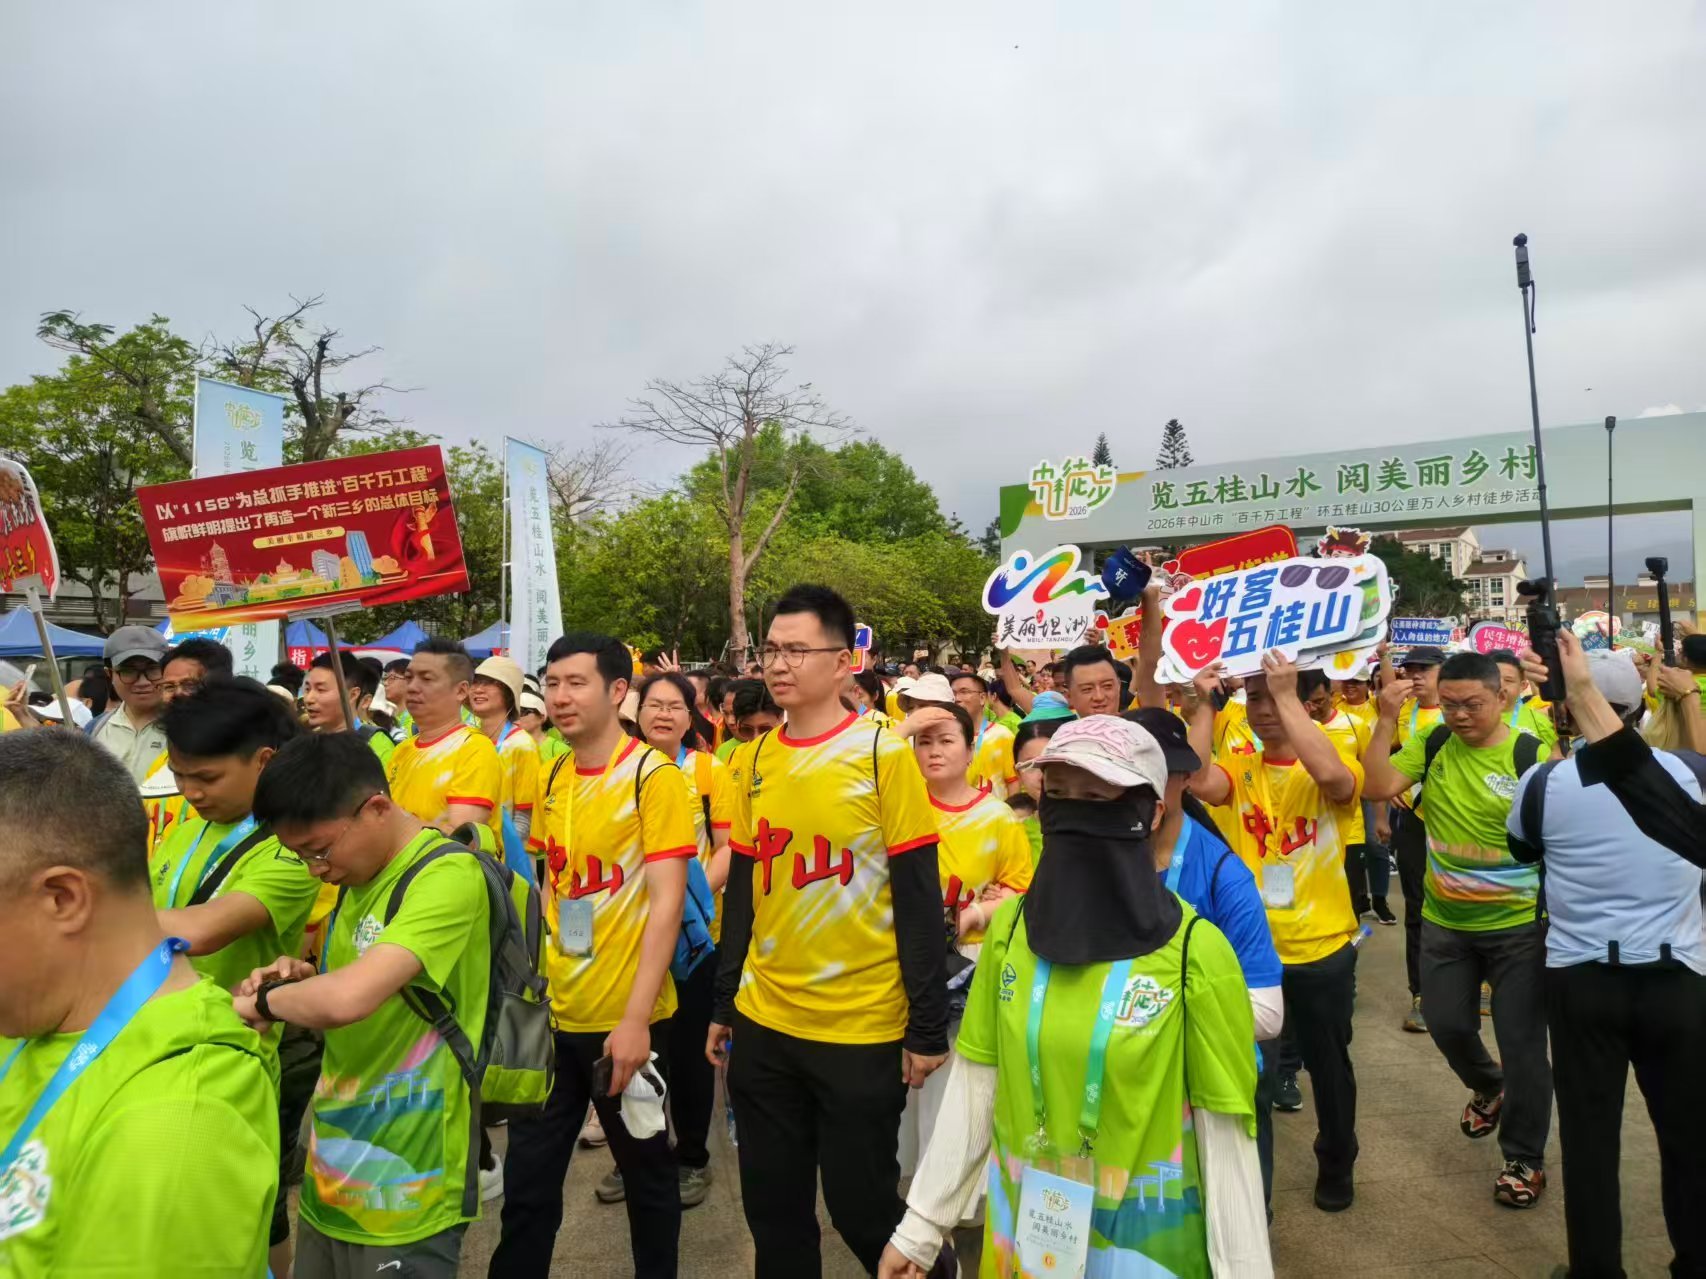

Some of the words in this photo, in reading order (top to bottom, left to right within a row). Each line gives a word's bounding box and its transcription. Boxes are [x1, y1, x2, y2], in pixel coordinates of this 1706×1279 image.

[1150, 466, 1322, 512] 览五桂山水
[1335, 444, 1537, 496] 阅美丽乡村
[162, 487, 439, 542] 旗帜鲜明提出了再造一个新三乡的总体目标
[1068, 506, 1087, 516] 2026
[1199, 567, 1279, 622] 好客
[1000, 613, 1089, 643] 美丽坦洲
[1221, 591, 1352, 659] 五桂山
[1393, 632, 1449, 642] 人人向往的地方
[753, 816, 854, 896] 中山
[1242, 803, 1318, 858] 中山
[548, 835, 624, 900] 中山
